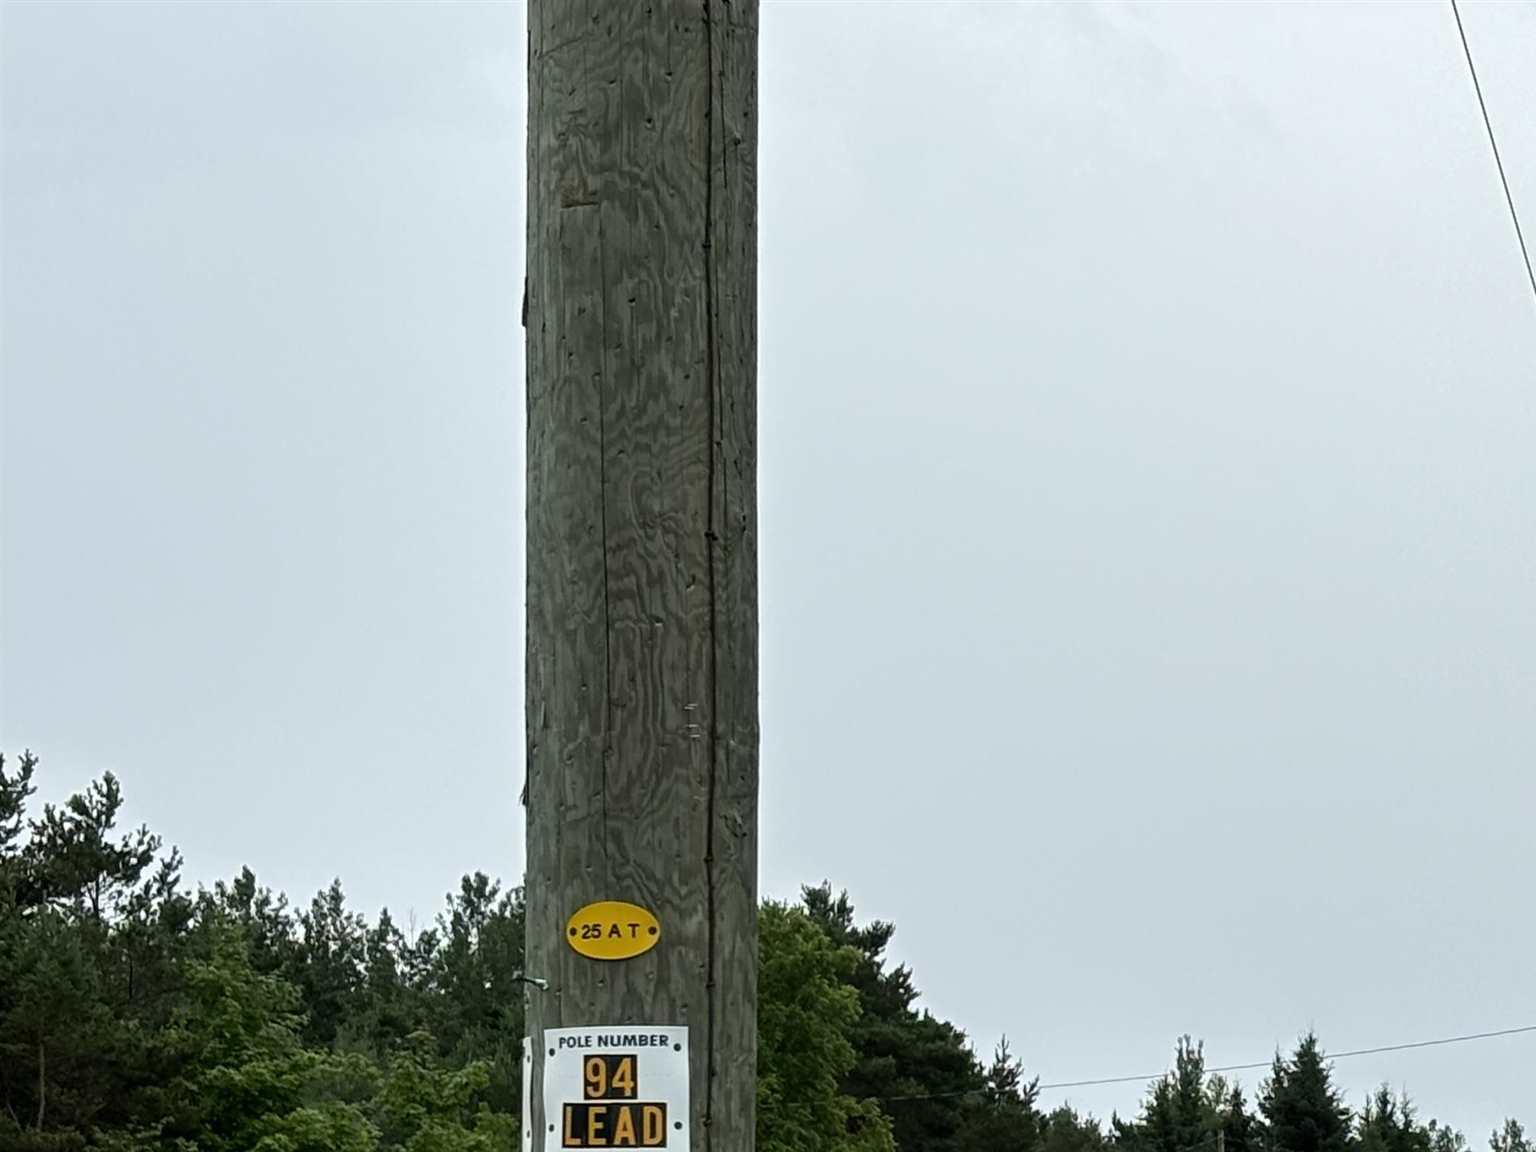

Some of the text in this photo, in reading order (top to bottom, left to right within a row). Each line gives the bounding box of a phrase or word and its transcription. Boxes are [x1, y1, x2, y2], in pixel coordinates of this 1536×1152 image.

[581, 924, 602, 939] 25
[559, 1034, 669, 1048] POLE NUMBER
[586, 1057, 635, 1098] 94
[564, 1105, 664, 1146] LEAD
